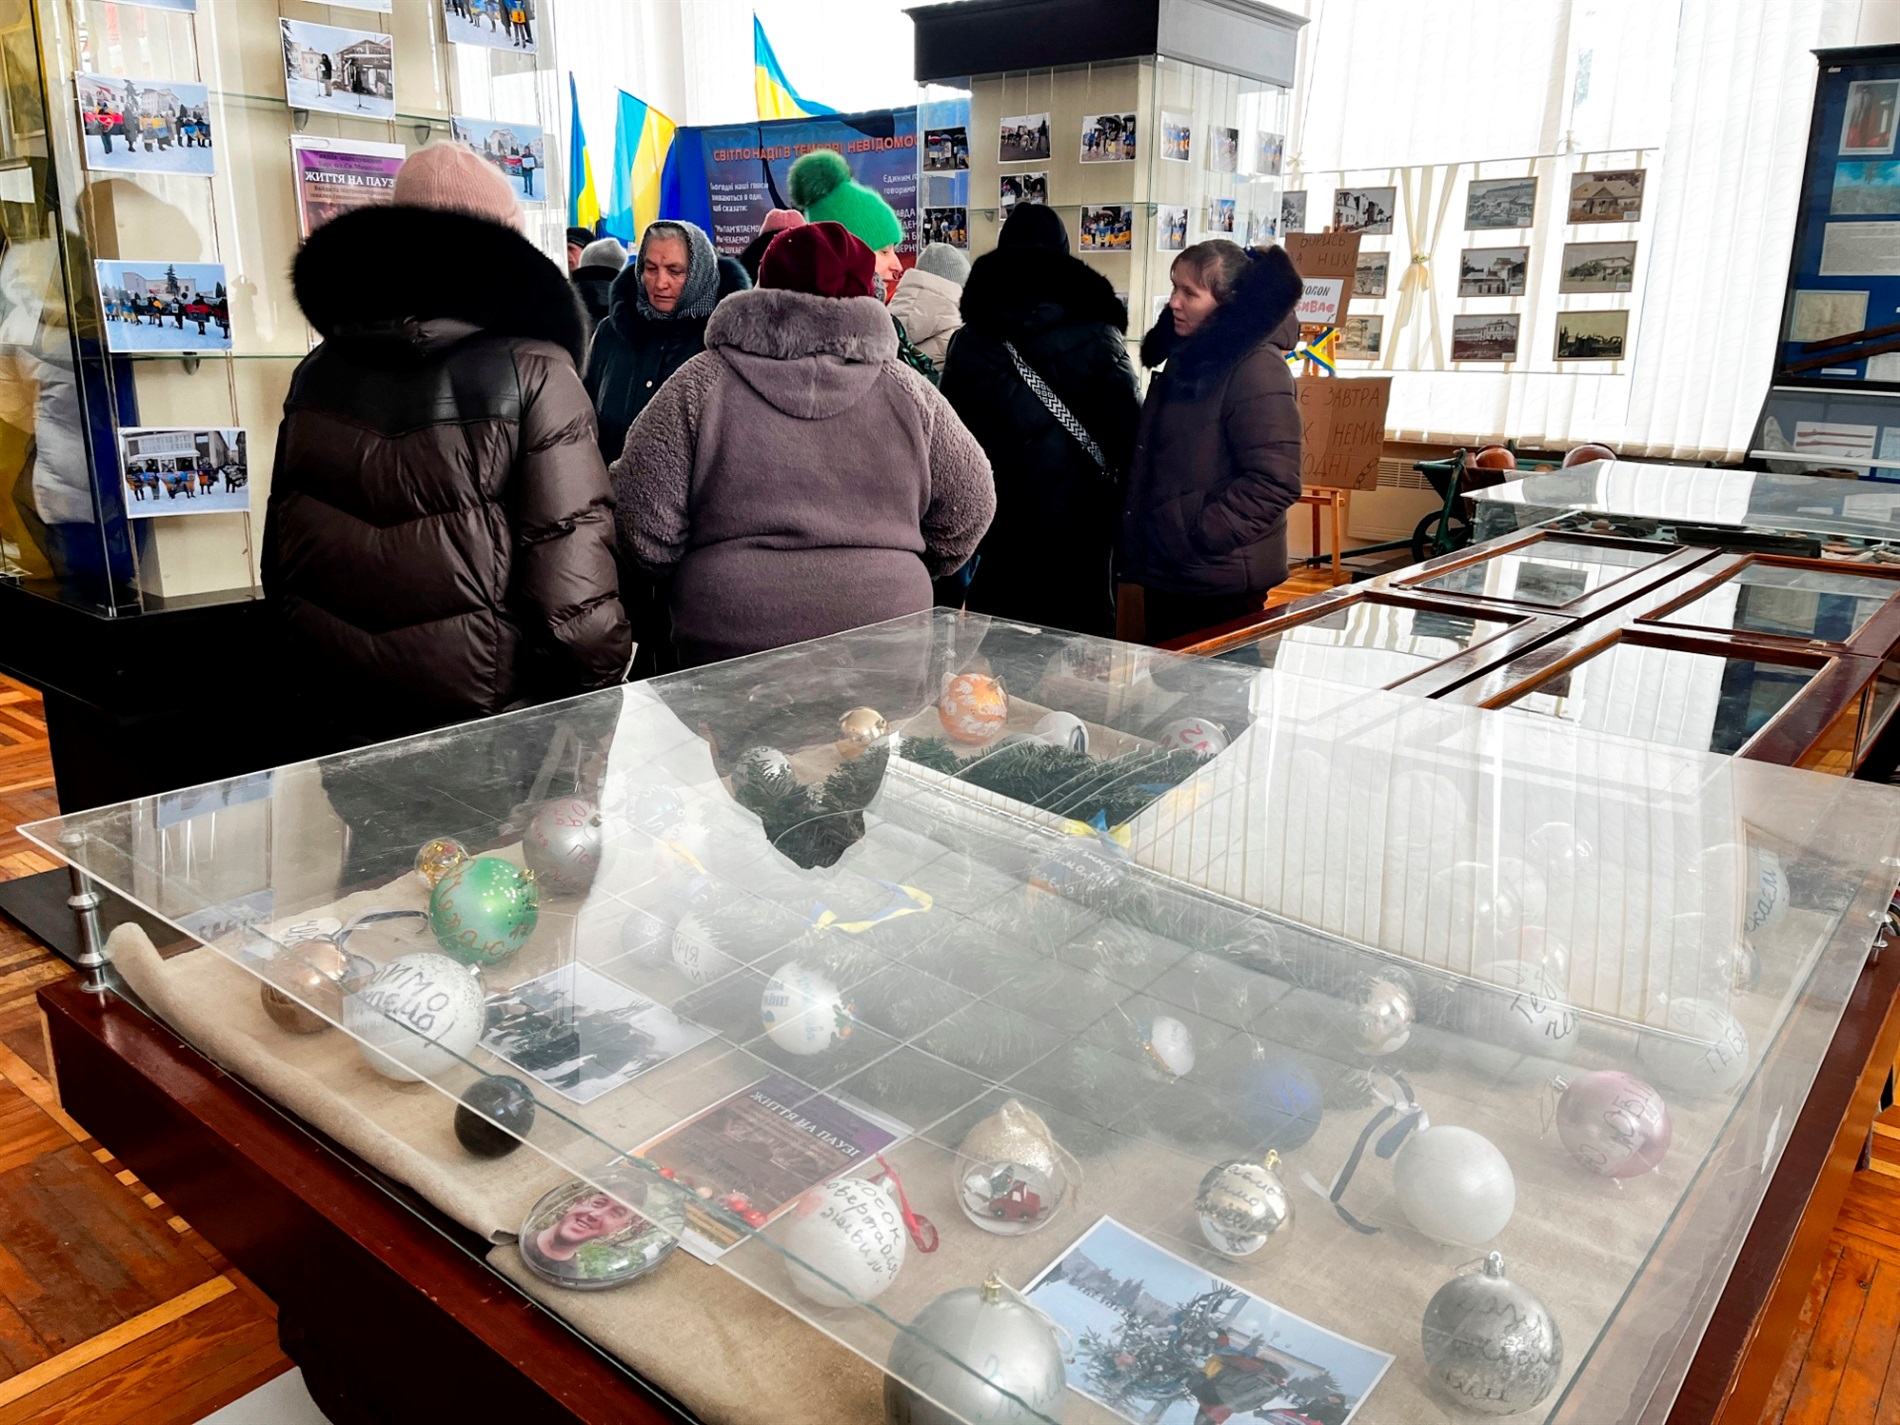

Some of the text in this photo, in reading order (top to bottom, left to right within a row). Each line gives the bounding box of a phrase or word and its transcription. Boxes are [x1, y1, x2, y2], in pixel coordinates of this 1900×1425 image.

[713, 148, 751, 162] СВІТЛО
[752, 144, 782, 160] НАДІЇ
[784, 146, 791, 158] В
[305, 171, 395, 188] ЖИТТЯ НА ПАУЗ
[1303, 285, 1330, 296] ОЛОН
[1324, 386, 1380, 408] ЗАВТРА
[1303, 421, 1314, 444] Х
[1303, 448, 1352, 477] ОДНІ
[749, 1090, 862, 1158] ЖИТТЯ НА ПАУЗІ
